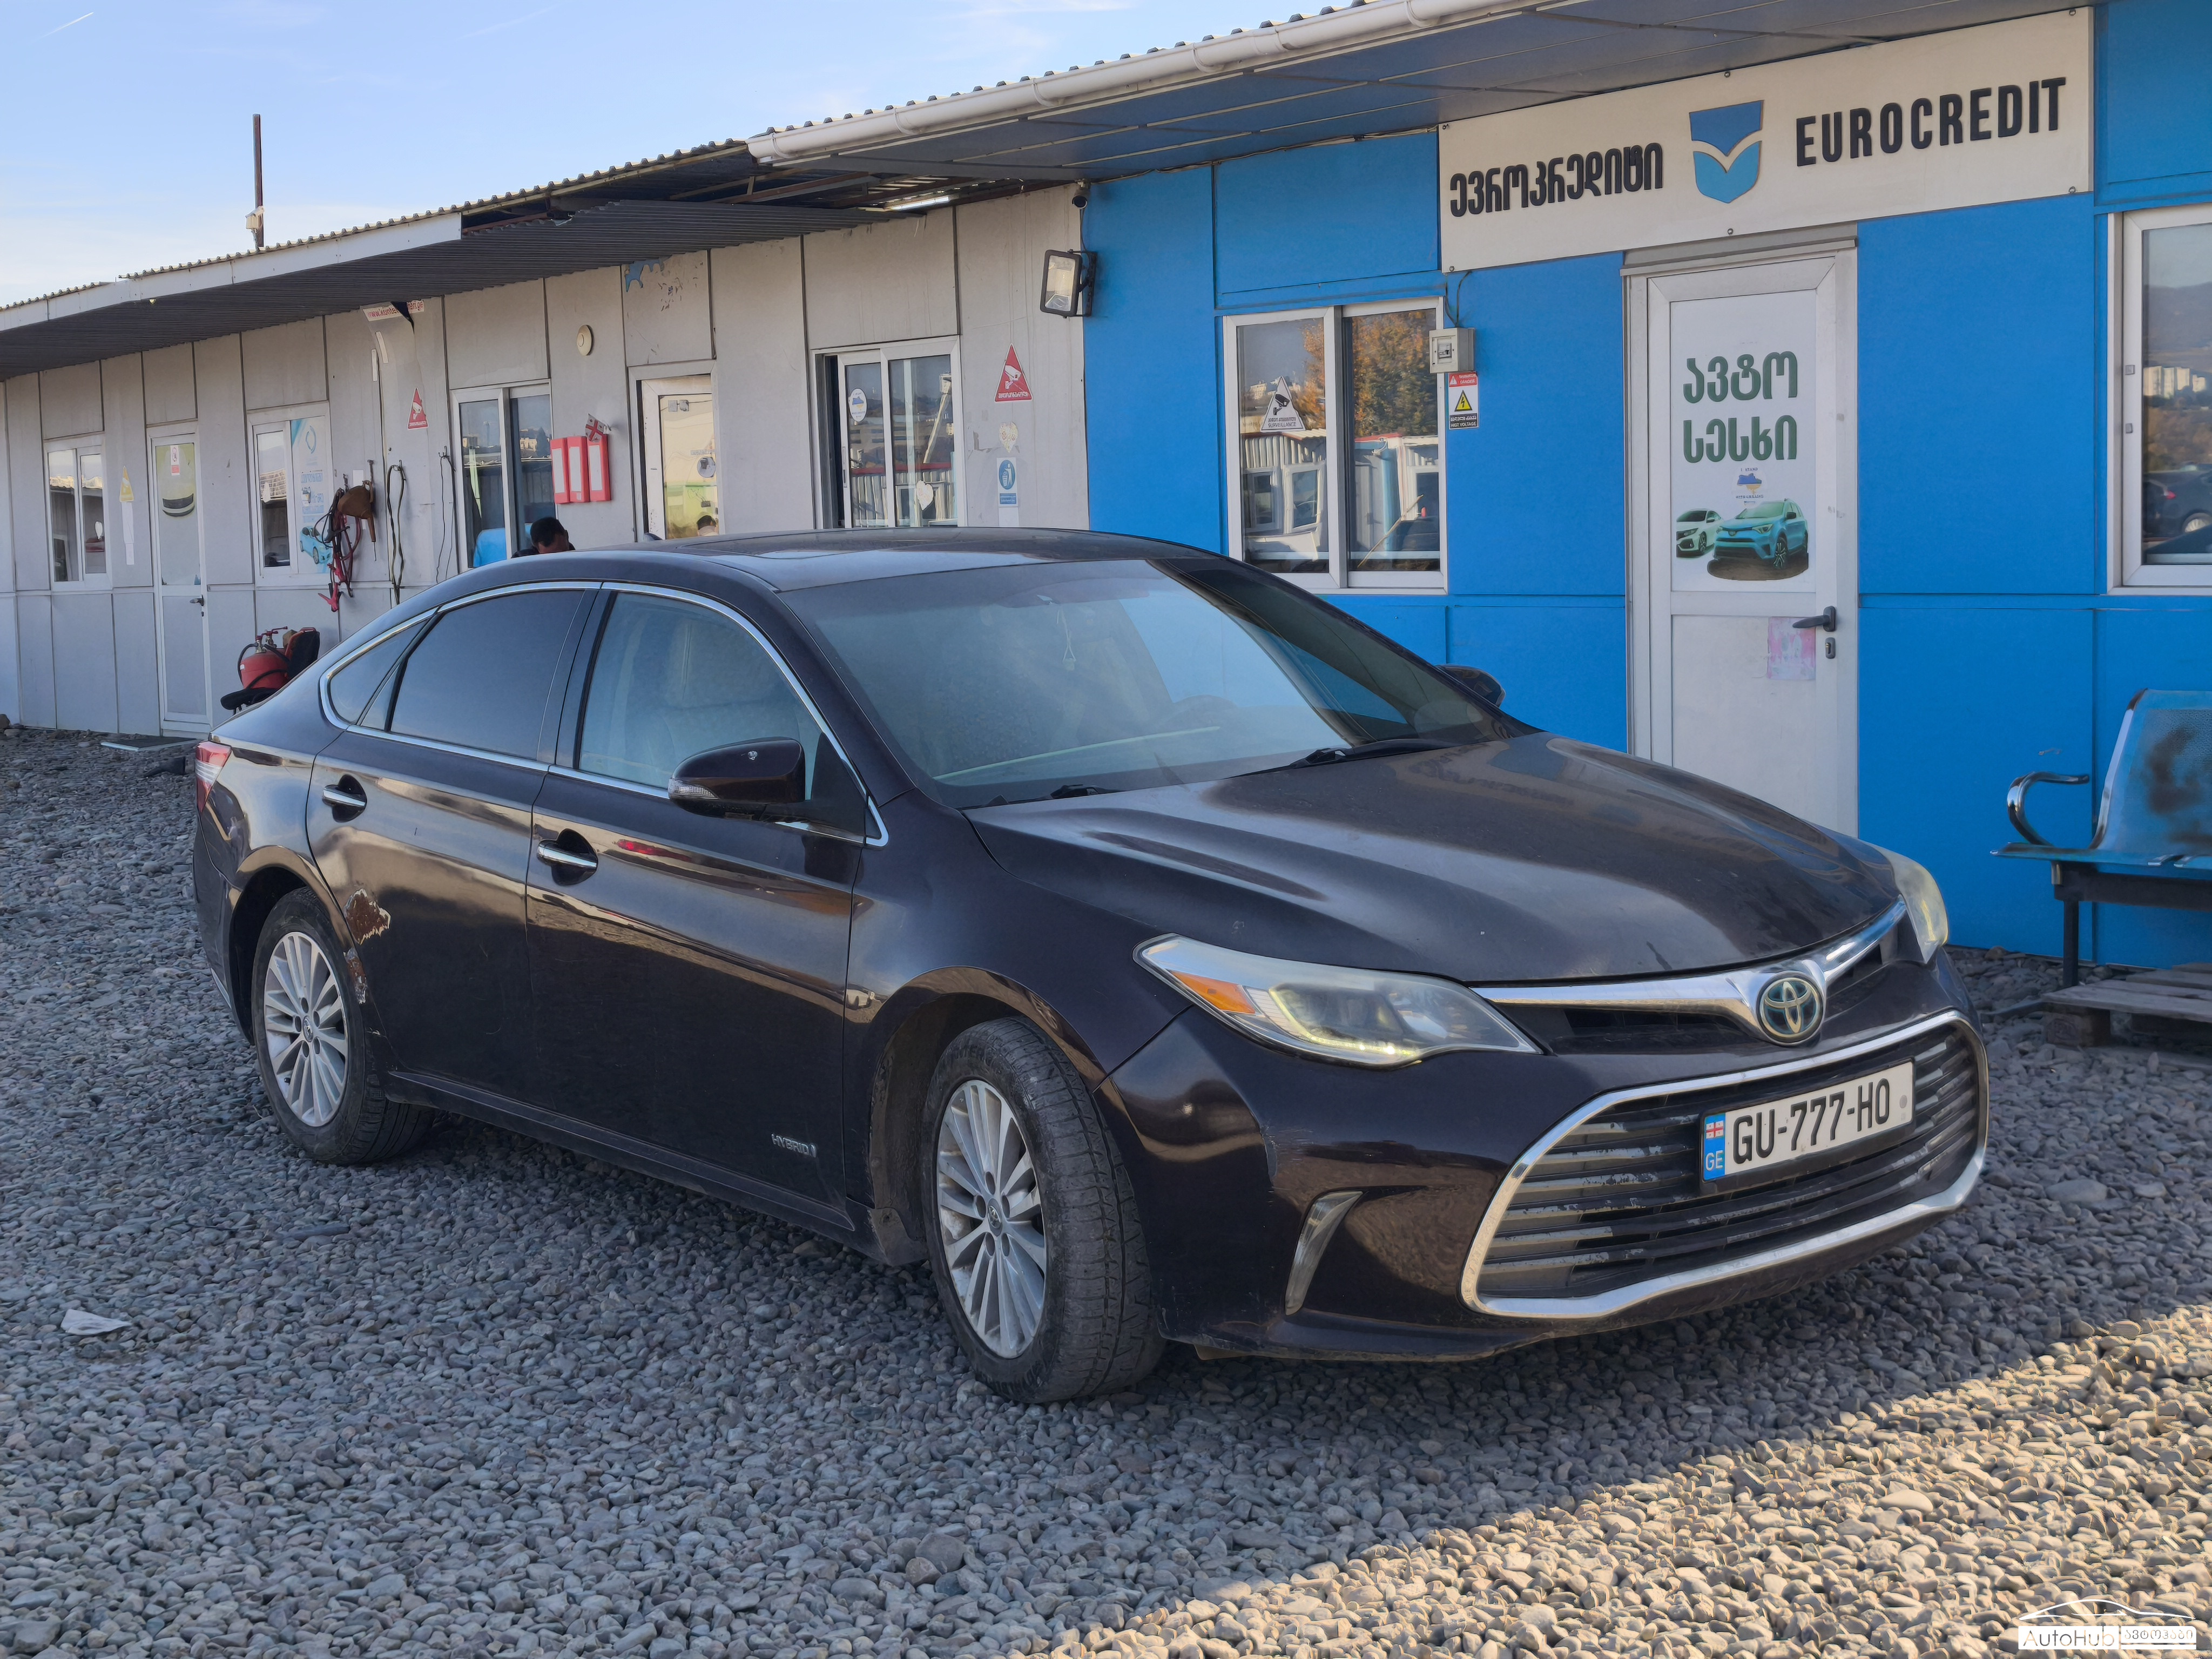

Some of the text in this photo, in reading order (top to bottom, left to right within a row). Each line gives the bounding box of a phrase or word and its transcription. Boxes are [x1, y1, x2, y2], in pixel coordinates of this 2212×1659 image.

[1796, 77, 2066, 167] EUROCREDIT
[1450, 142, 1663, 217] ევროკრედიტი
[1683, 351, 1797, 403] ავტო
[1683, 415, 1797, 463] სესხი
[1733, 1078, 1890, 1164] GU-777-HO
[1705, 1150, 1723, 1171] GE
